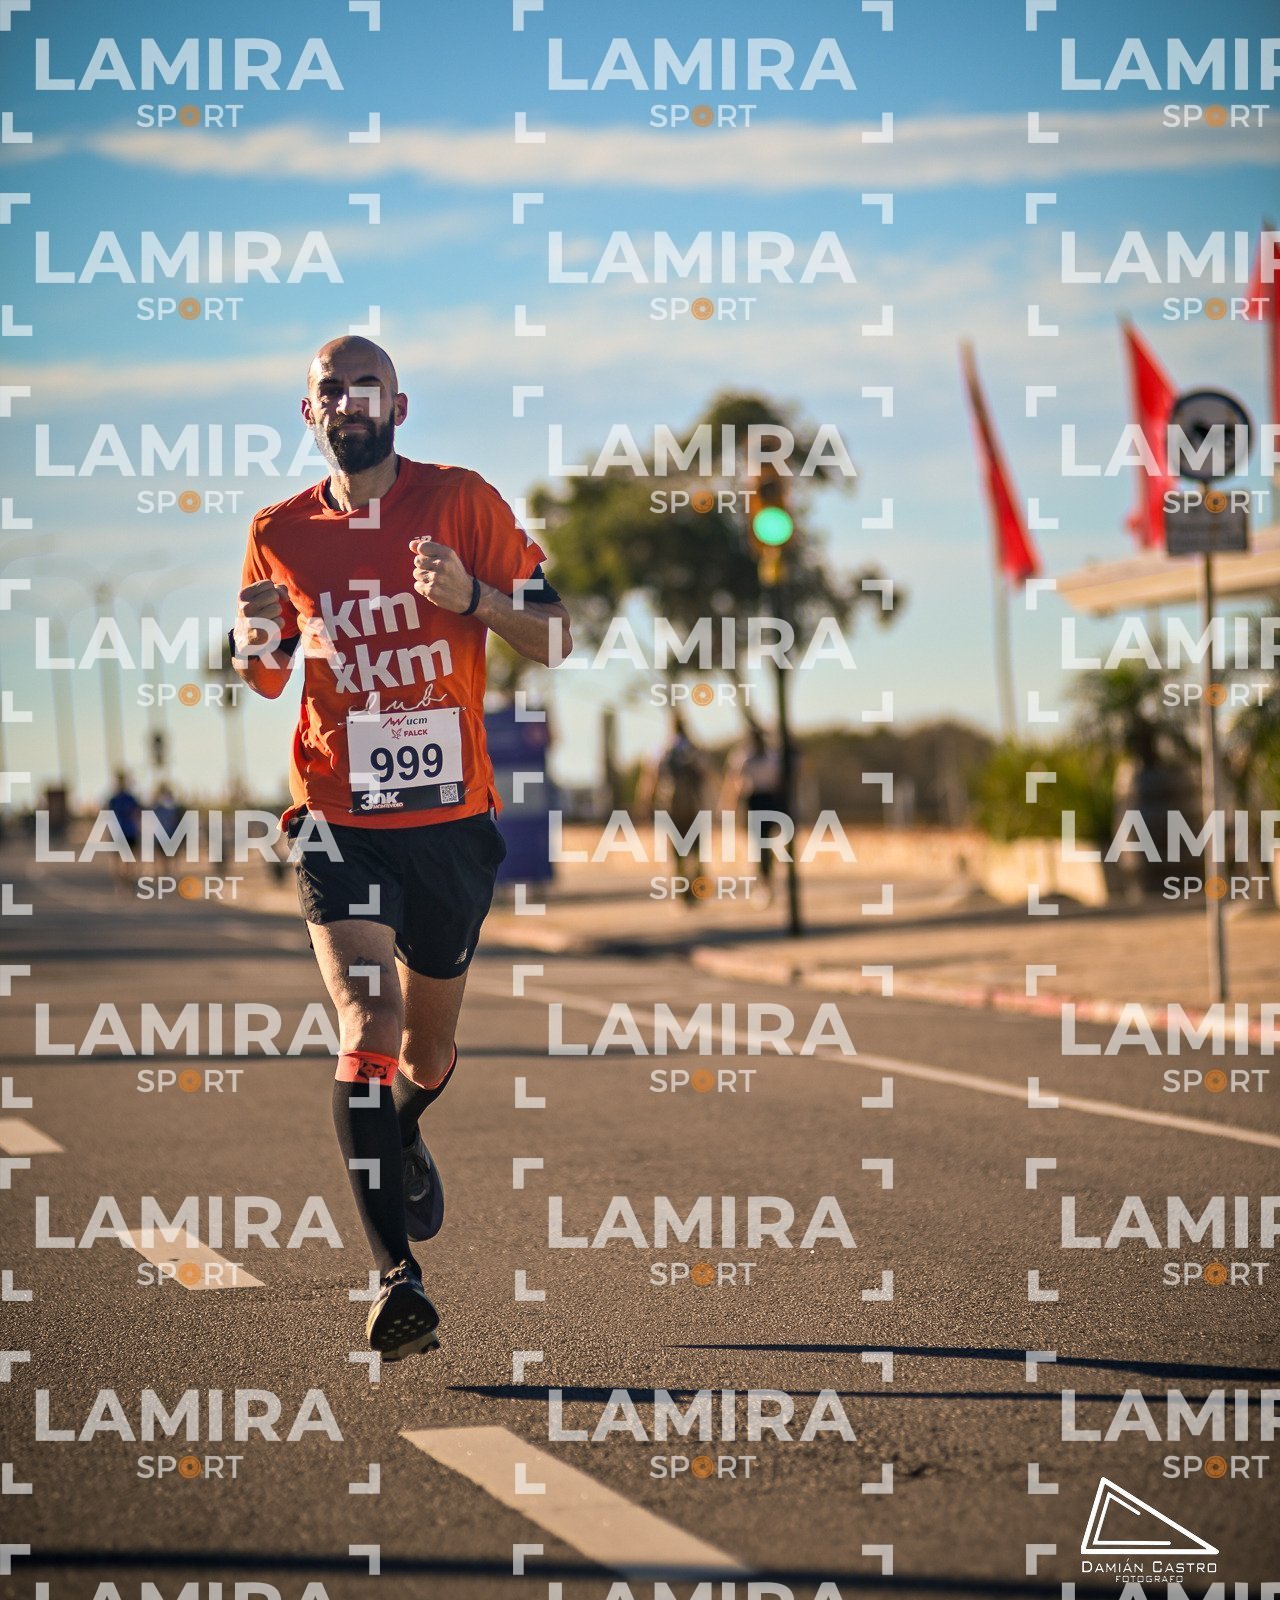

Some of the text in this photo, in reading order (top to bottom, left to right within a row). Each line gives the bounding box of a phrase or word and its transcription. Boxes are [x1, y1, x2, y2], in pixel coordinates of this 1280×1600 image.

[320, 591, 420, 641] km
[406, 717, 428, 726] ucm
[404, 728, 428, 737] FALCK
[370, 743, 443, 783] 999
[361, 791, 400, 810] 30K
